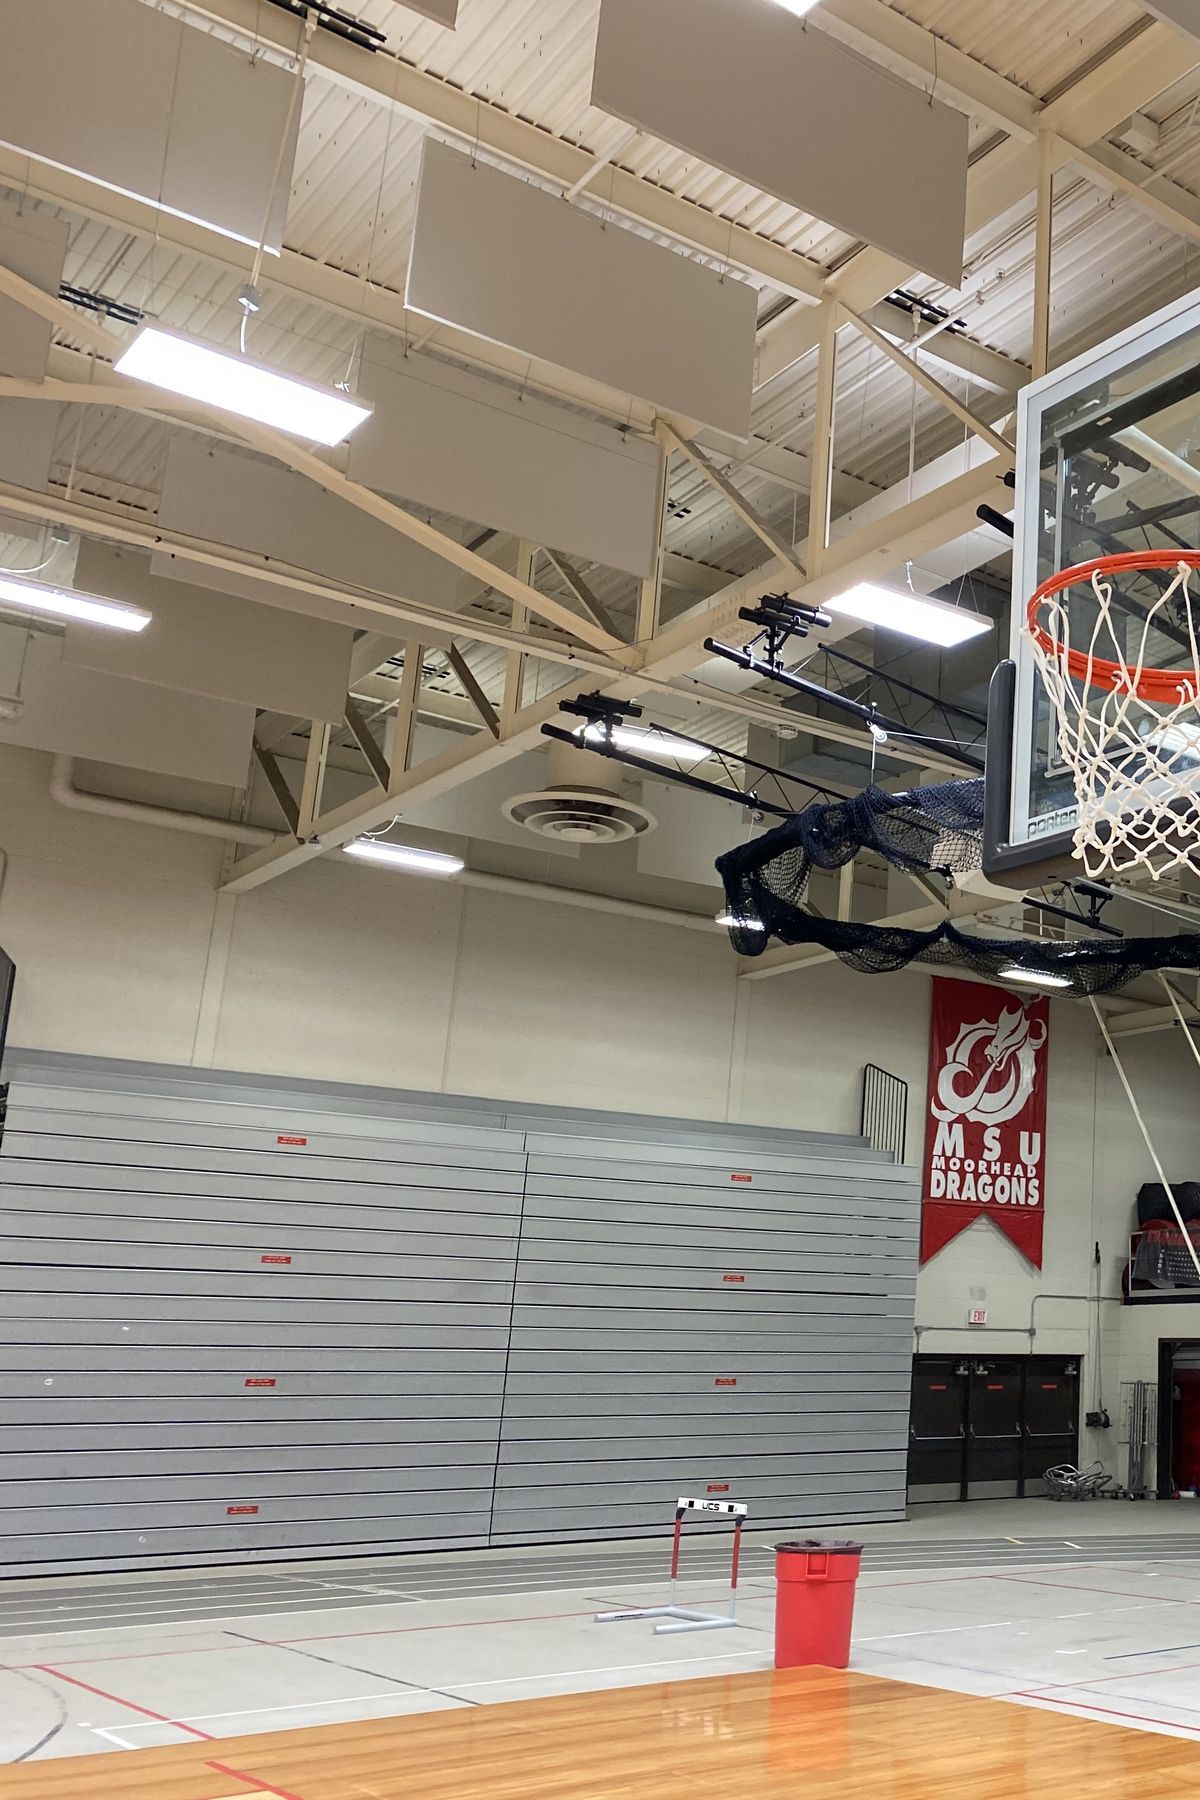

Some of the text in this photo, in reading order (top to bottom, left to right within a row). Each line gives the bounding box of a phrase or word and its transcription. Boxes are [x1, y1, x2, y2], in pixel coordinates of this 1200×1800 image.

[932, 1156, 1036, 1177] MOORHEAD
[930, 1170, 1039, 1206] DRAGONS
[702, 1502, 720, 1511] UCS
